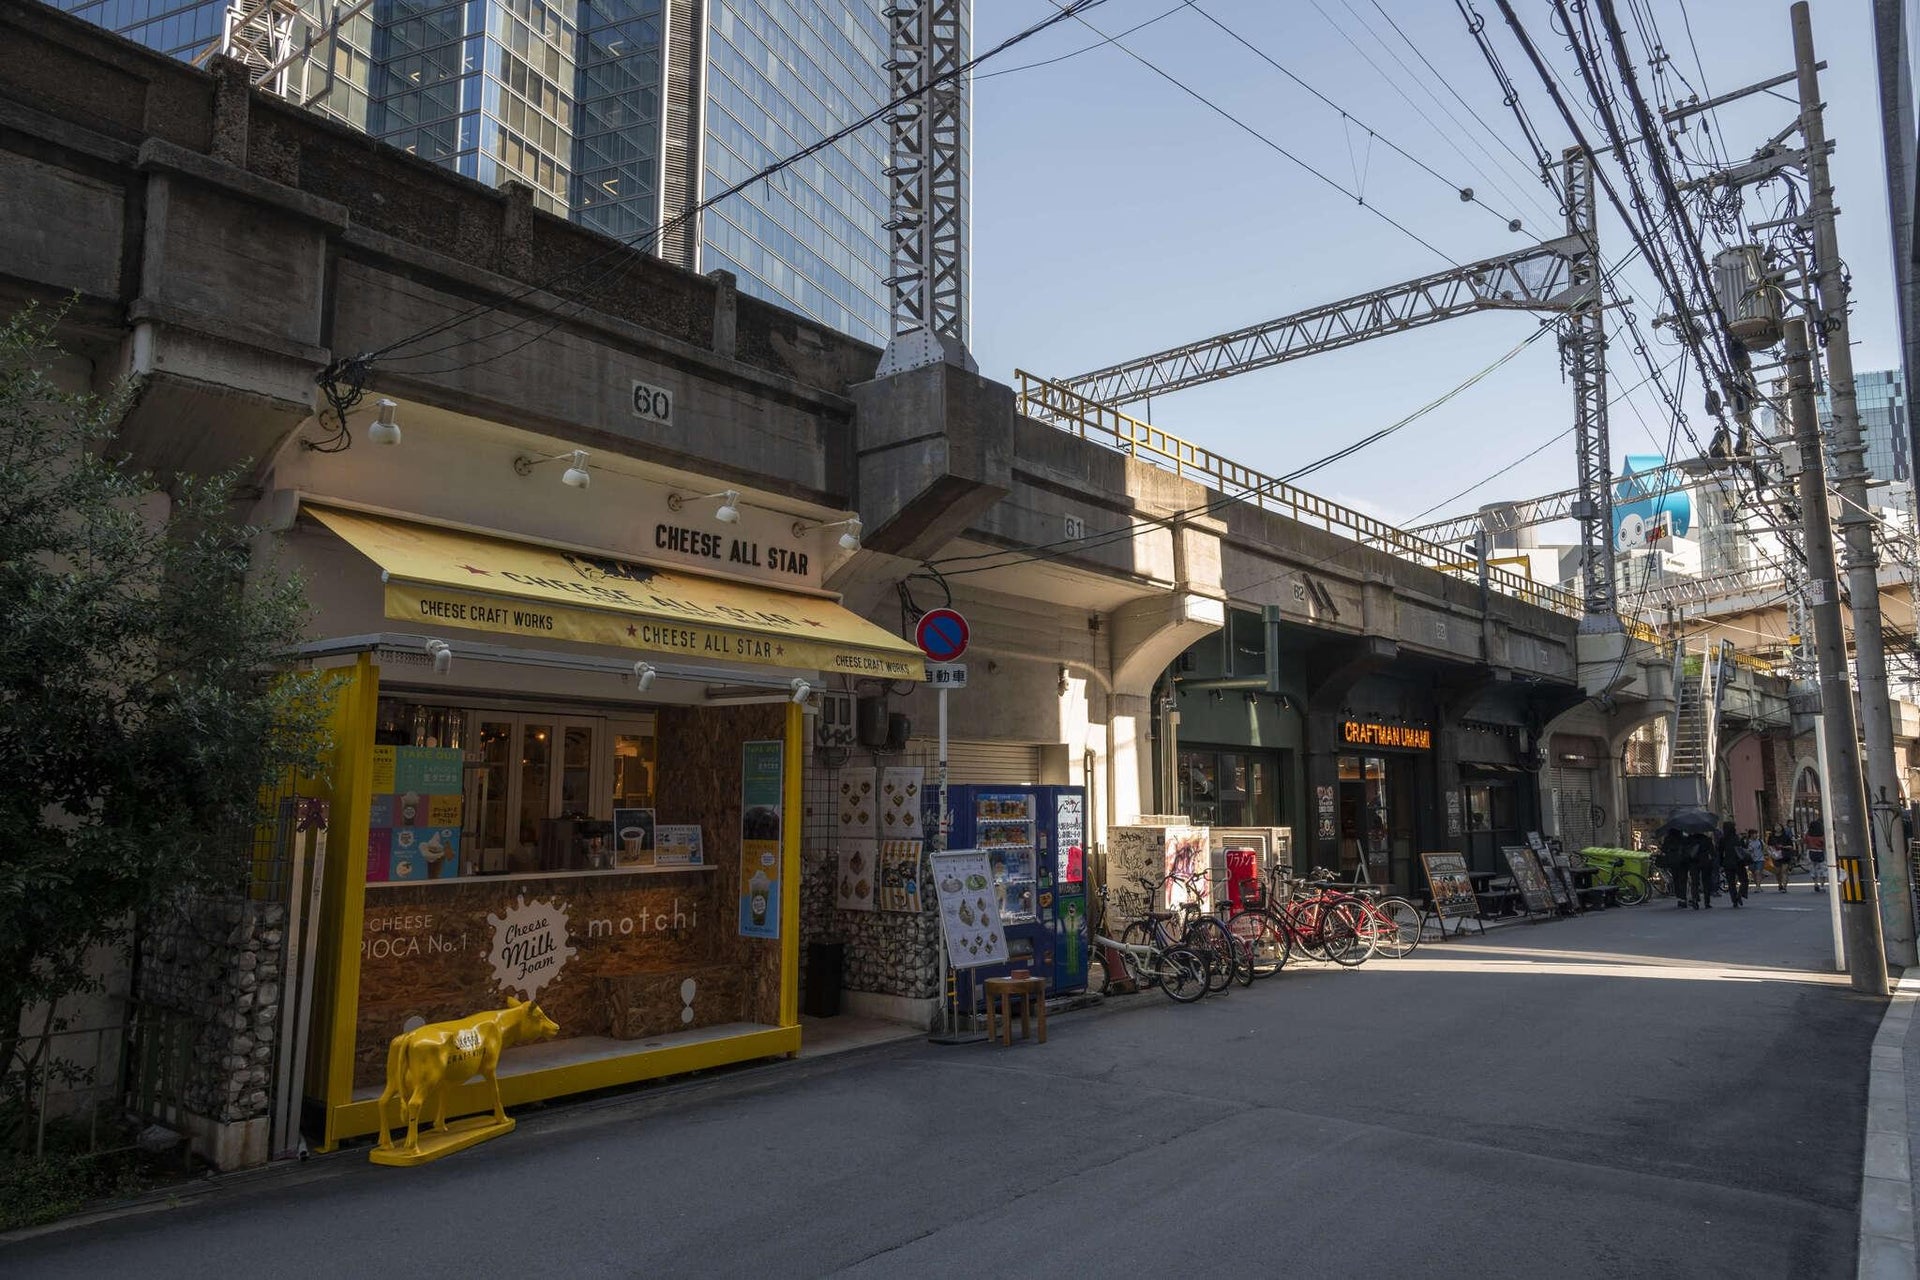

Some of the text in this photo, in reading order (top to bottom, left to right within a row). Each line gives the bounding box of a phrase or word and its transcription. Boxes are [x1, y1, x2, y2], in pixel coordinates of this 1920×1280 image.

[634, 386, 669, 419] 60
[1066, 518, 1081, 539] 61
[655, 524, 808, 576] CHEESE ALL STAR
[501, 571, 802, 626] CHEESE ALL STAR
[420, 599, 553, 631] CHEESE CRAFT WORKS
[643, 625, 771, 658] CHEESE ALL STAR
[835, 654, 909, 675] CHEESE CRAFT WORKS
[924, 669, 966, 684] 自動車
[1345, 721, 1431, 749] CRAFTMAN UMAMI
[402, 750, 433, 759] TAKE
[370, 914, 433, 932] CHEESE
[505, 918, 549, 945] Cheese
[589, 898, 697, 937] motchi
[502, 931, 557, 969] Milk
[517, 955, 554, 980] Foam
